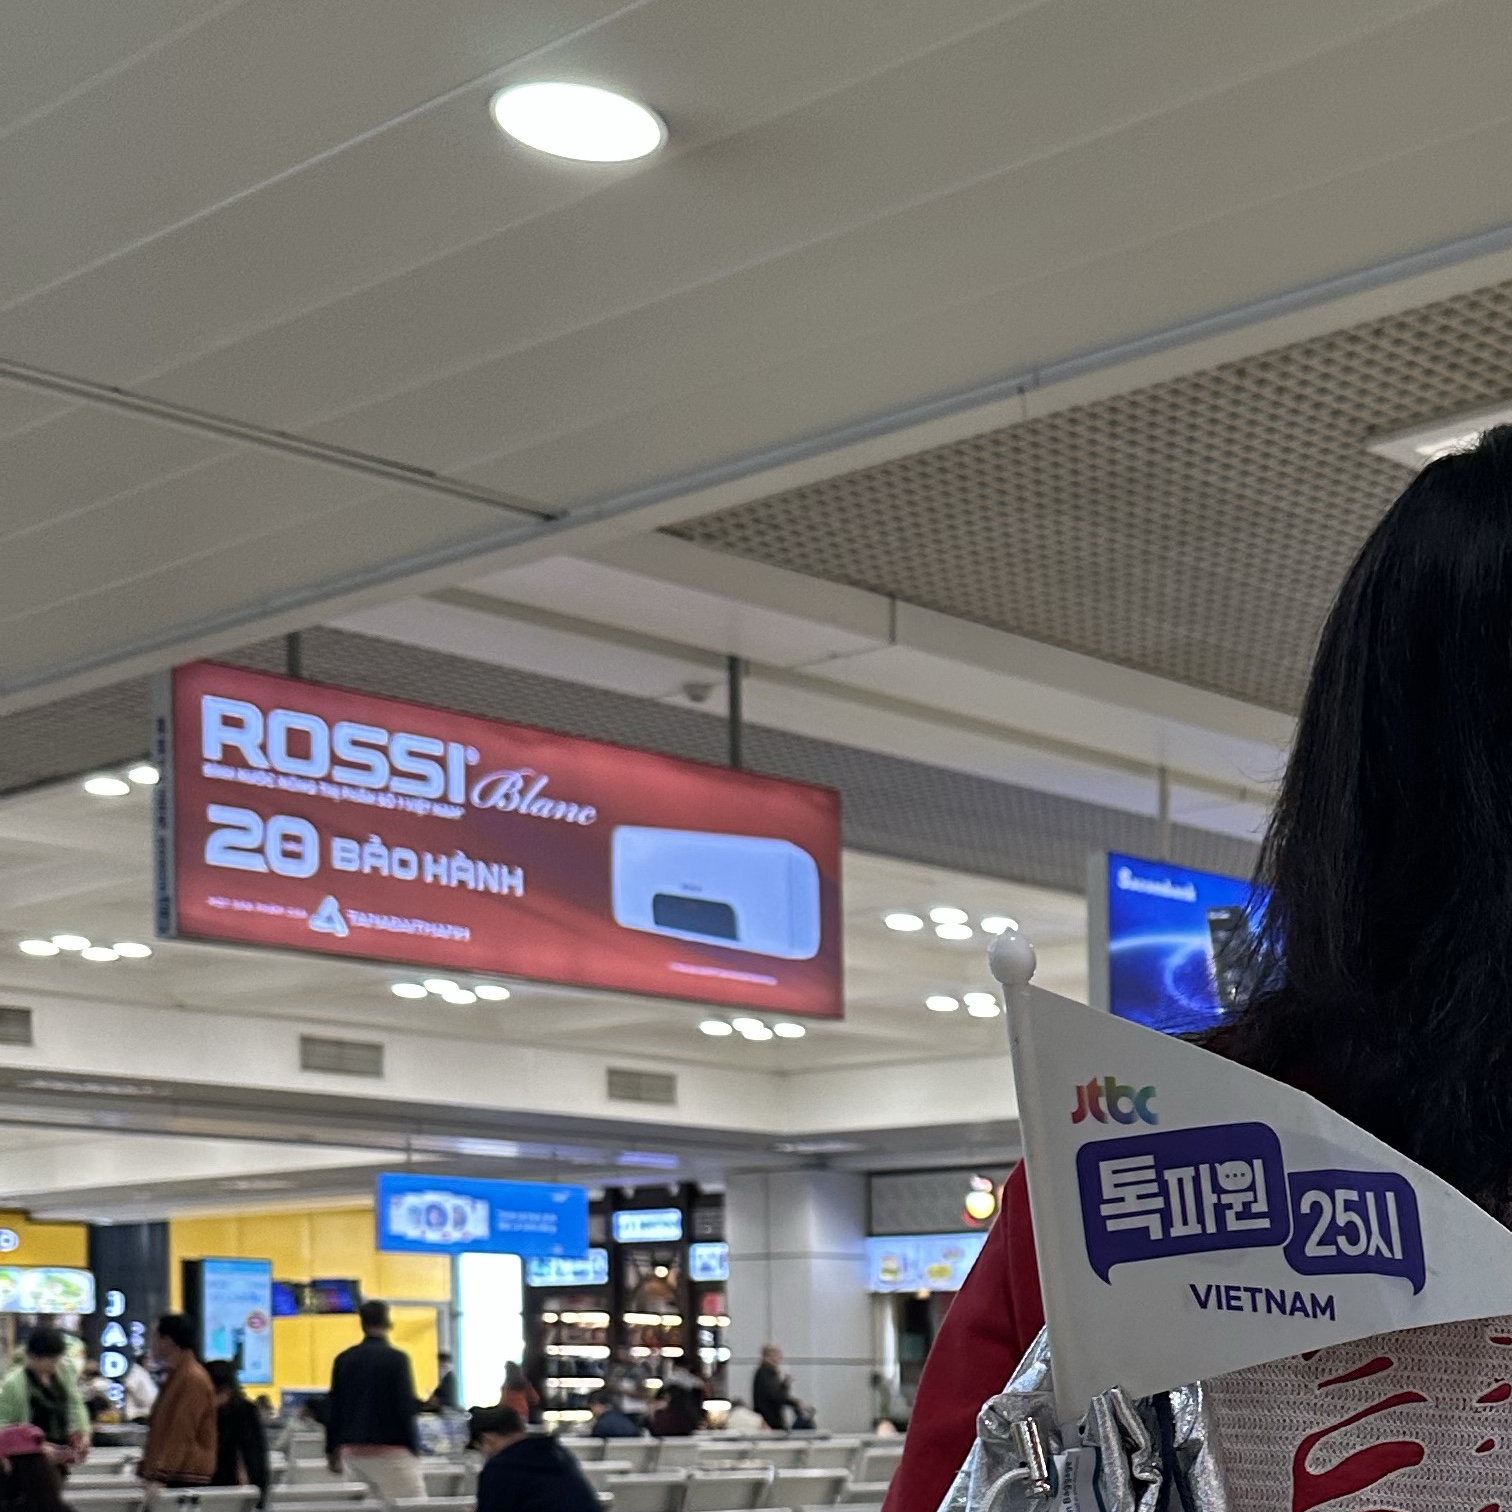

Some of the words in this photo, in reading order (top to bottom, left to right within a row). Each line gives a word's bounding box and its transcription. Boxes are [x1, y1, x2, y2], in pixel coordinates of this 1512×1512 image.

[470, 768, 598, 826] Blanc
[204, 803, 321, 879] 20
[330, 832, 419, 881] BẢO
[423, 849, 525, 897] HÀNH
[1099, 1154, 1271, 1241] 톡파원
[1300, 1189, 1403, 1260] 25시
[1189, 1283, 1337, 1322] VIETNAM
